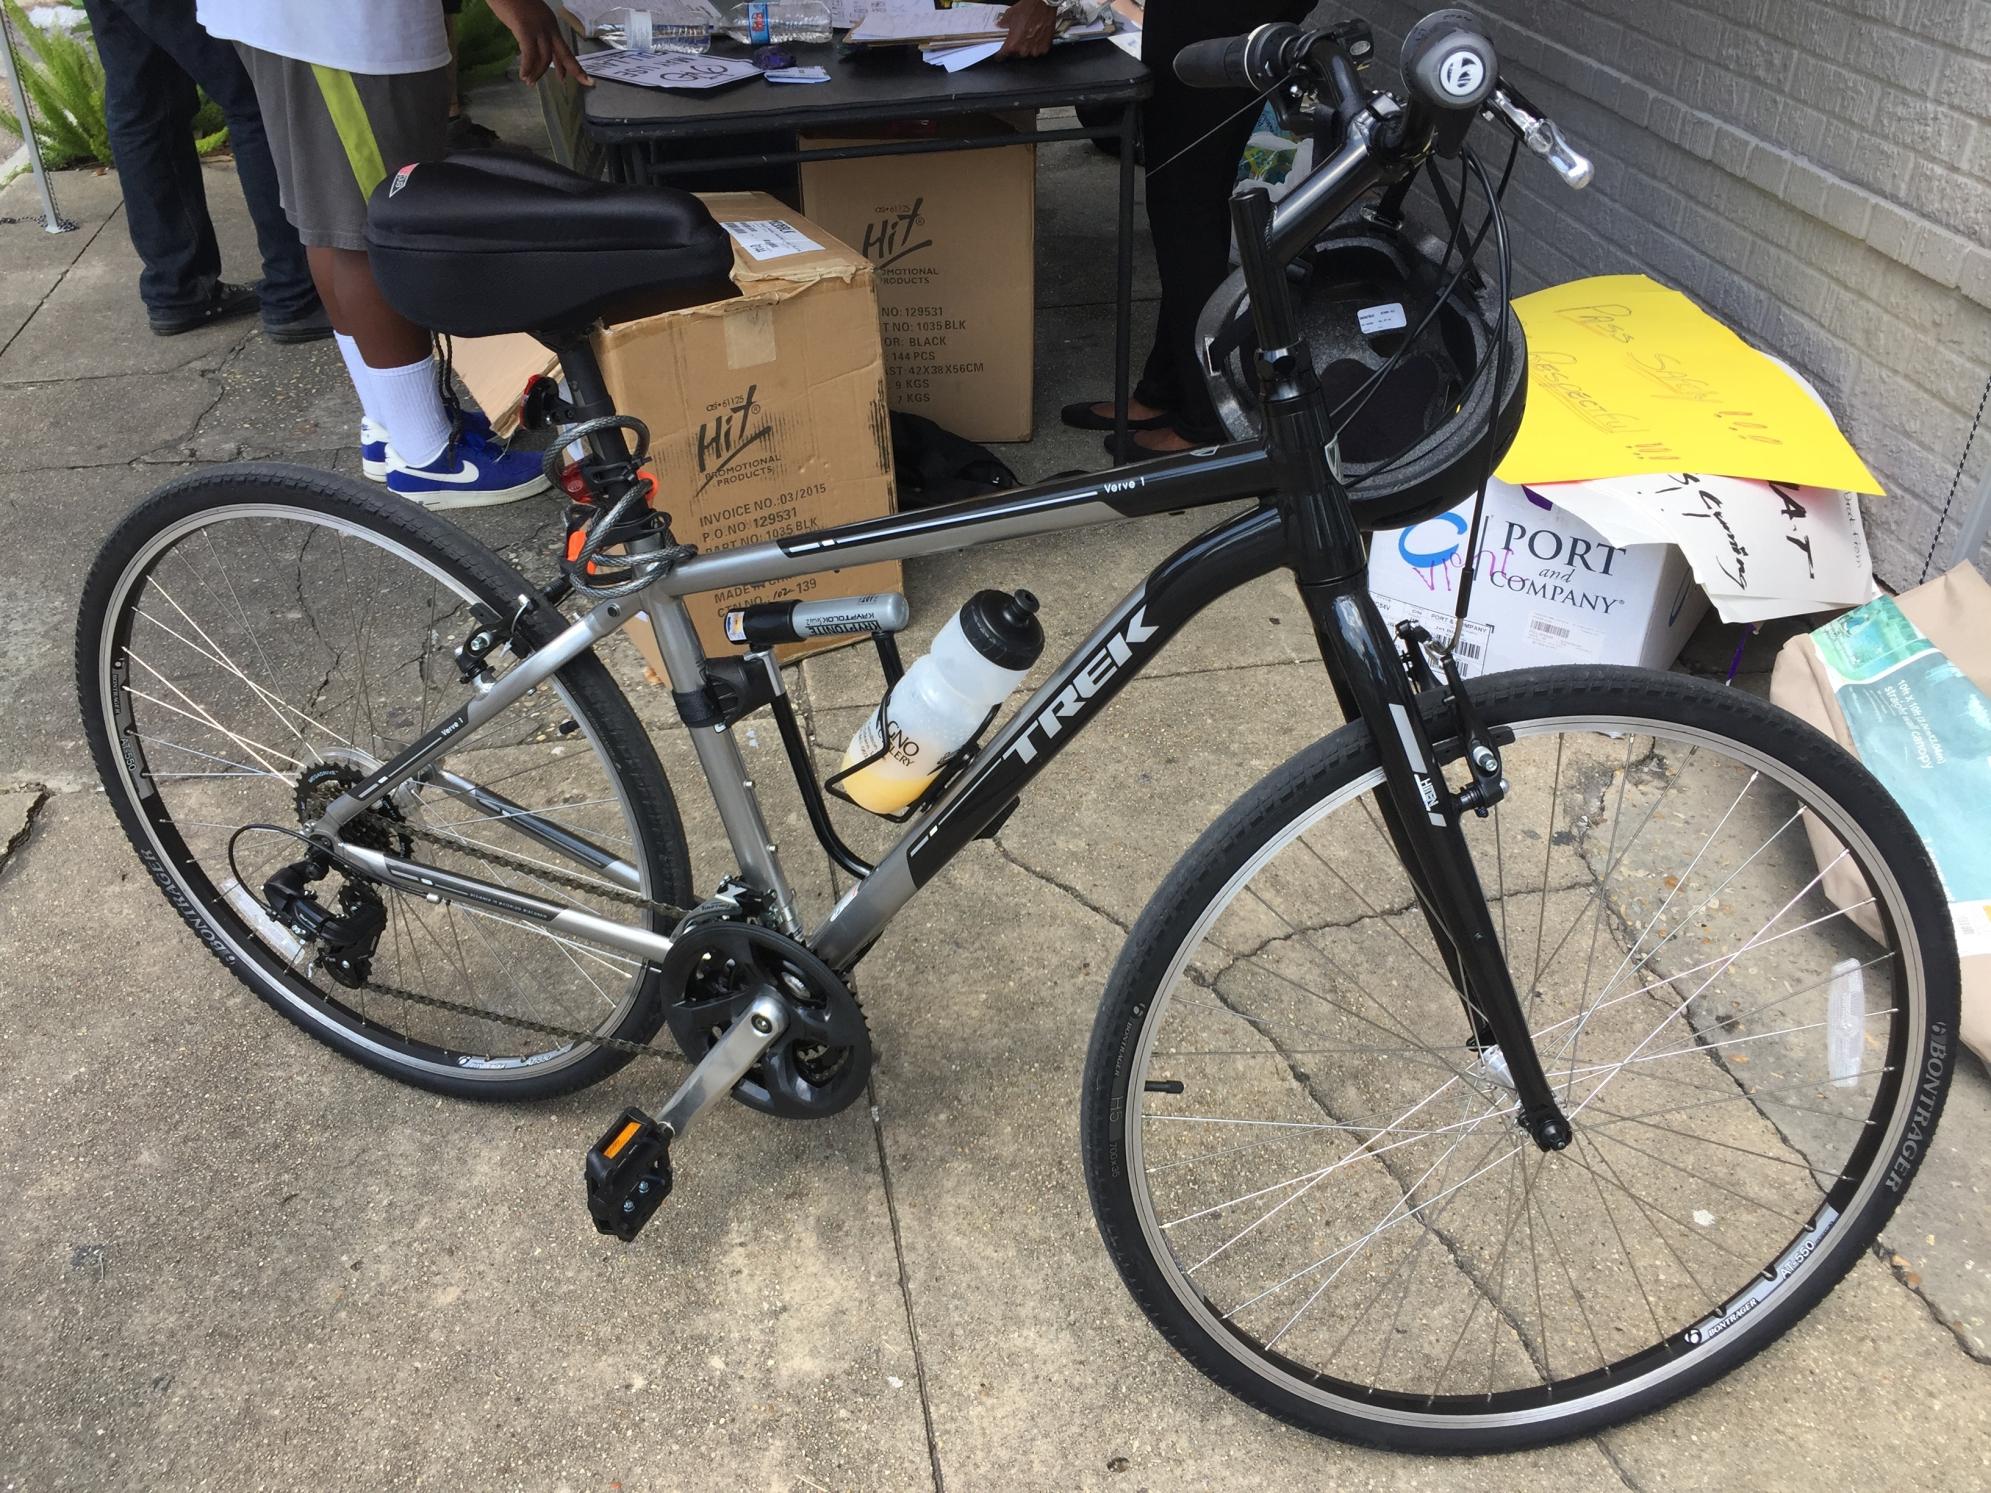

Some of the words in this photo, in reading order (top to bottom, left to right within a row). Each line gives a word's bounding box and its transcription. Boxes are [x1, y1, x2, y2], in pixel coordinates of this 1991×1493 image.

[862, 198, 924, 259] Hit
[905, 306, 944, 317] 129531
[909, 336, 947, 347] BLACK
[906, 379, 930, 388] KGS
[906, 393, 931, 403] KGS
[697, 384, 758, 474] Hit
[705, 454, 783, 480] PROMOTIONAL
[716, 466, 774, 486] PRODUCTS
[1104, 481, 1136, 493] Verve
[1140, 477, 1146, 487] 1
[699, 503, 752, 527] INVOICE
[753, 507, 798, 528] 129531
[1501, 520, 1628, 577] PORT
[796, 578, 818, 594] 139
[1538, 567, 1576, 584] and
[714, 584, 752, 604] MADE
[808, 620, 882, 636] KRYPTONITE
[1002, 604, 1160, 765] TREK
[886, 720, 919, 757] GNO
[1911, 730, 1934, 769] canopy
[119, 737, 136, 773] AT-550
[141, 848, 229, 958] BONTRAGER
[1114, 1021, 1134, 1077] BONTRAGER
[1885, 1036, 1948, 1194] BONTRAGER
[1780, 1238, 1816, 1282] AT-550
[1708, 1297, 1759, 1338] BONTRAGER
